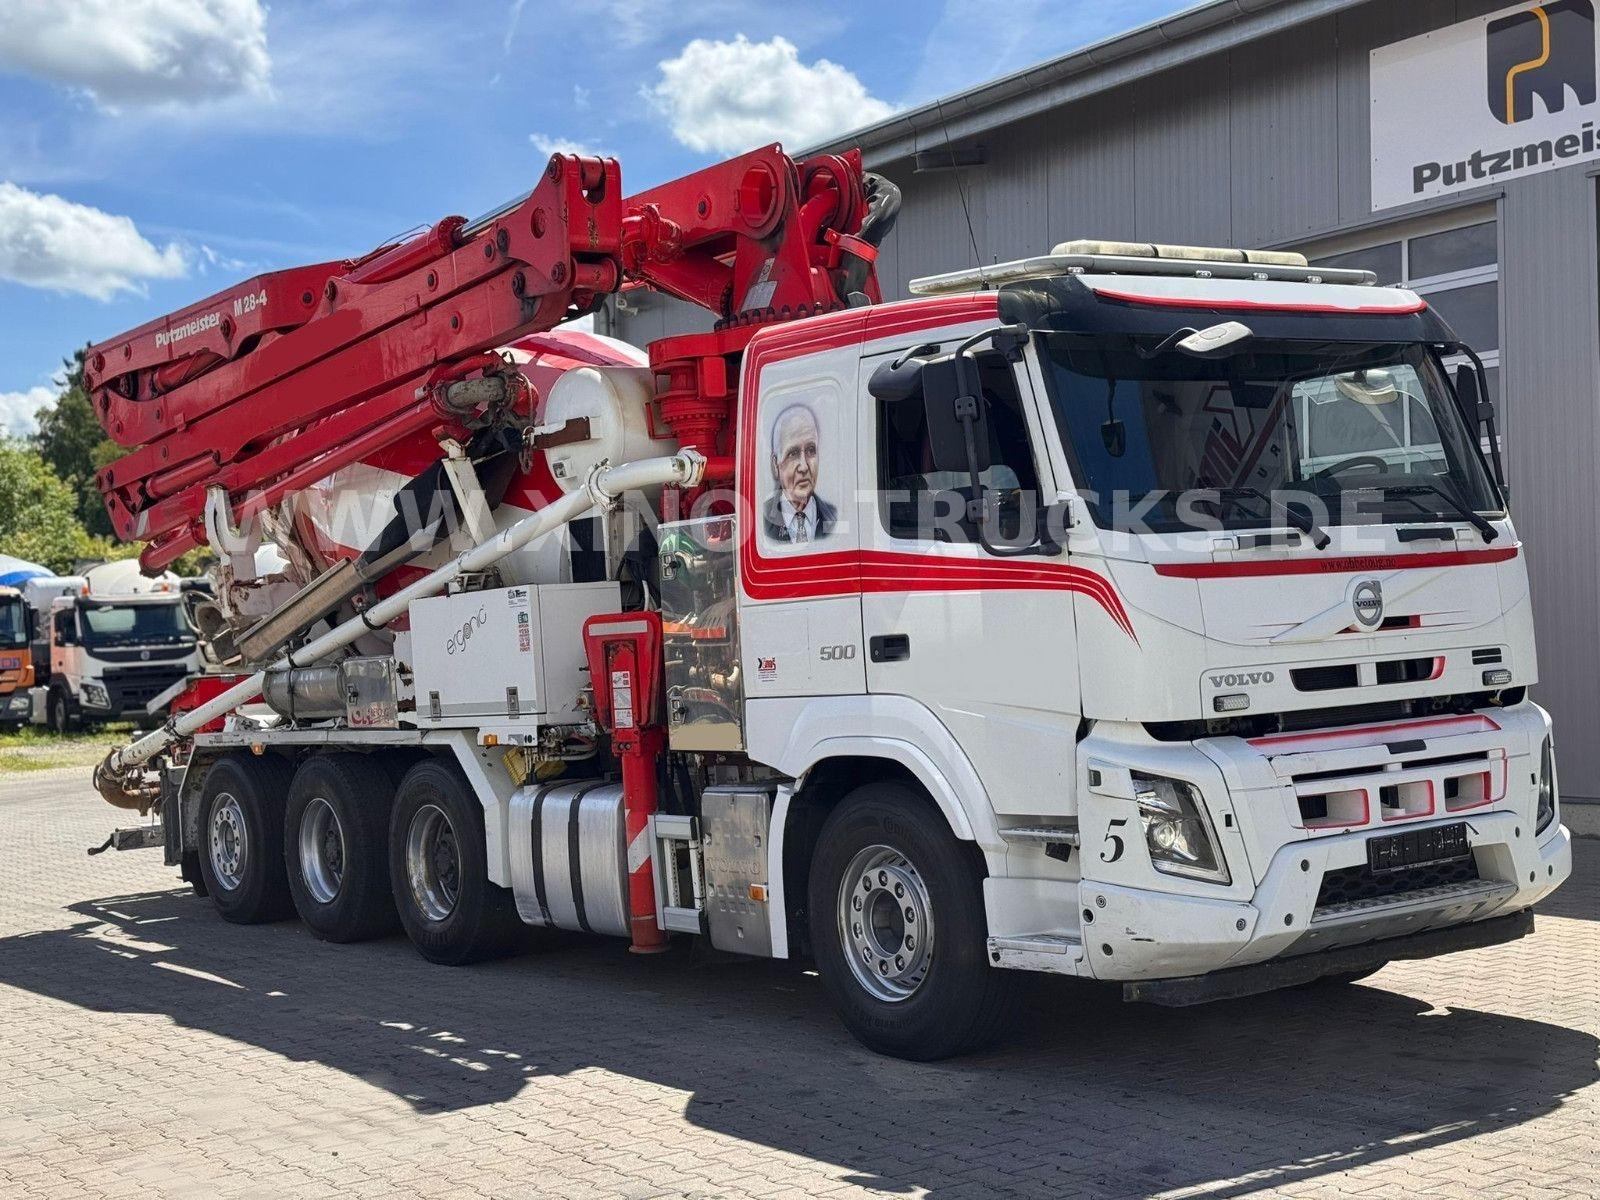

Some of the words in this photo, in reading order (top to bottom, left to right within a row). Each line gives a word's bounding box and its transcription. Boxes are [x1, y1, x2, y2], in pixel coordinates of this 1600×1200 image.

[1413, 121, 1600, 193] Putzmei
[155, 311, 220, 348] Putzmeister
[233, 298, 243, 317] M
[244, 289, 268, 313] 28-4
[1355, 600, 1381, 608] VOLVO
[446, 604, 487, 655] ergonic
[820, 645, 856, 660] 500
[1209, 671, 1274, 687] VOLVO
[1100, 817, 1128, 863] 5
[706, 857, 761, 874] VOLVO
